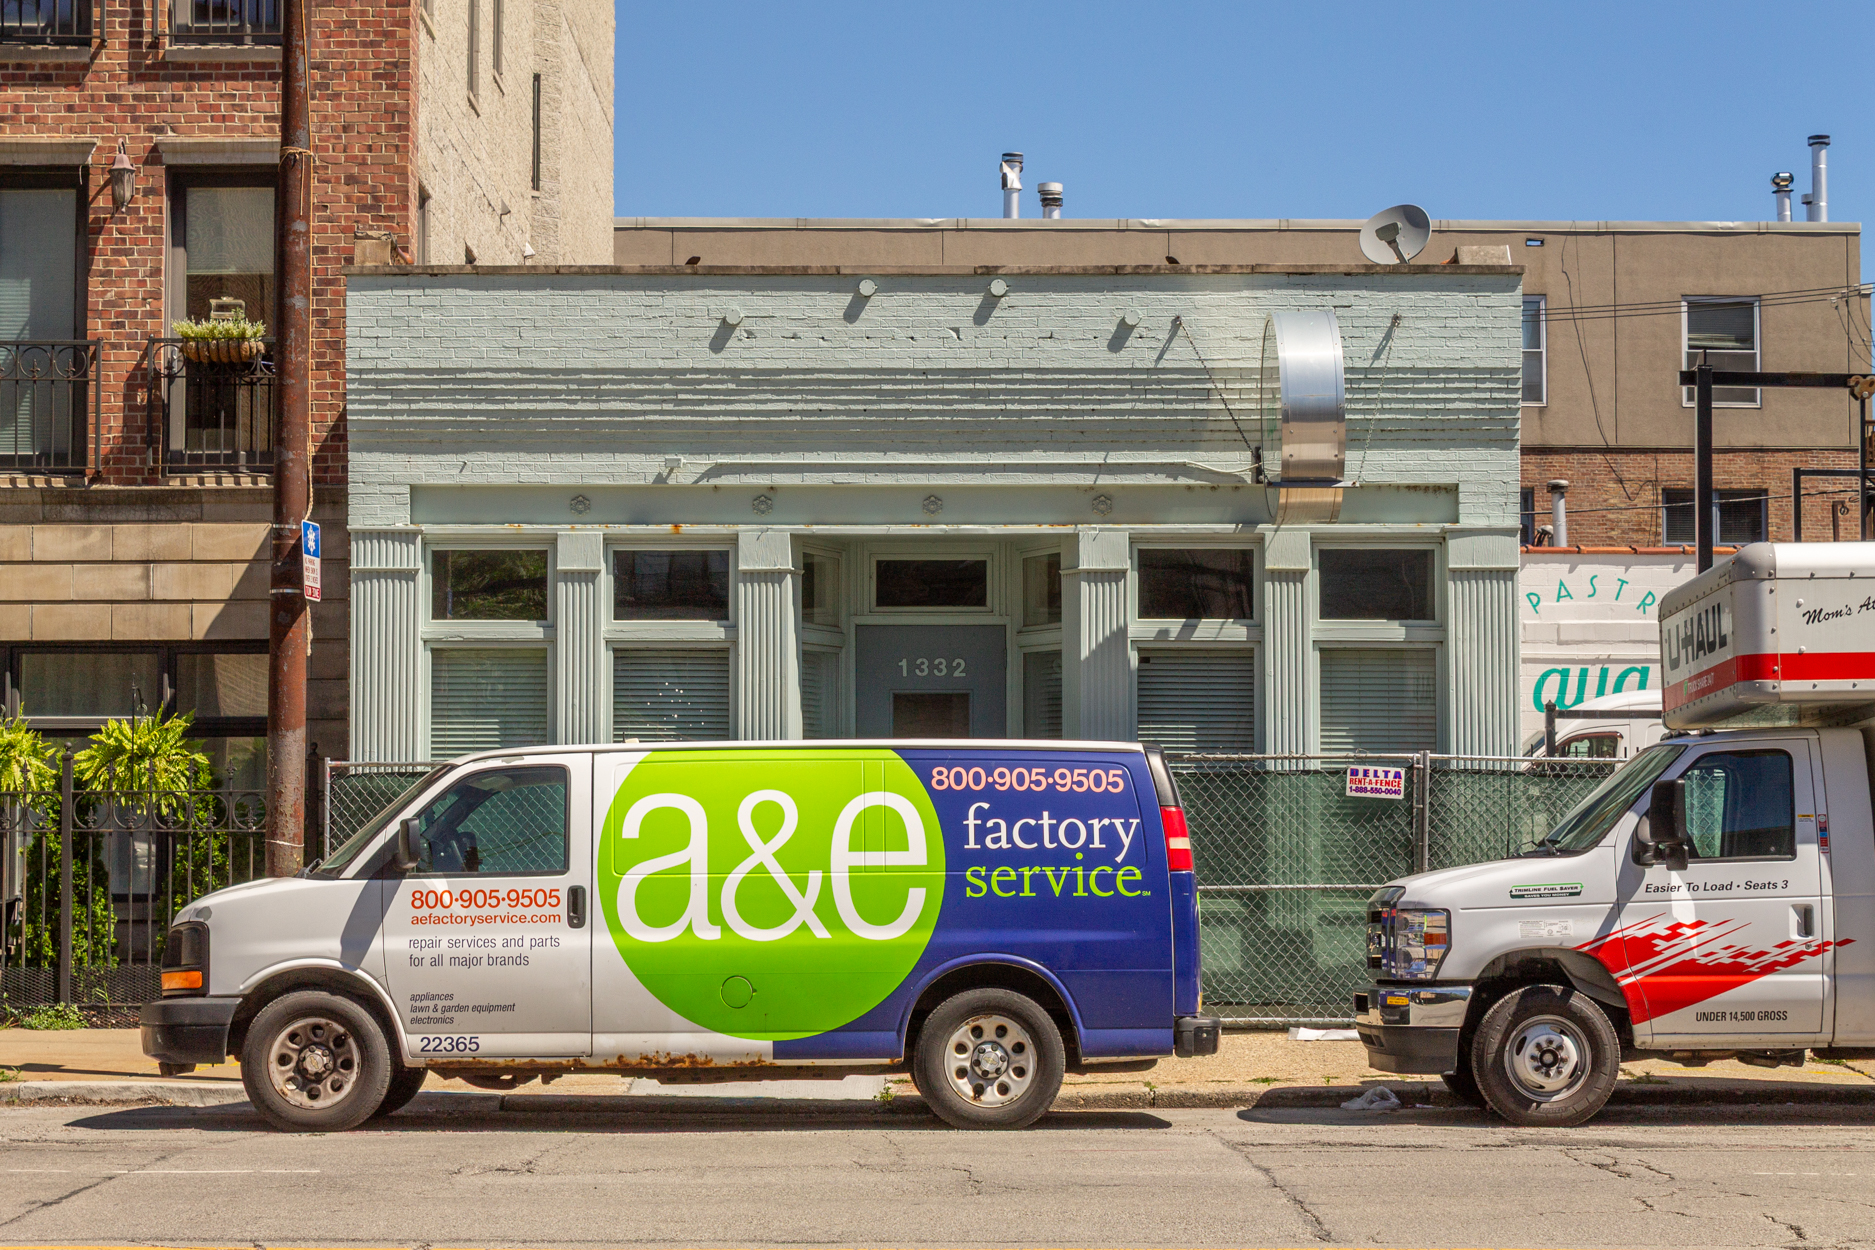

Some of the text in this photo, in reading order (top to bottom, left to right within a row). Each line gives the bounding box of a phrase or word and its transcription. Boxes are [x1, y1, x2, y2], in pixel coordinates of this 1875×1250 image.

[1802, 604, 1853, 625] Mom's
[898, 657, 967, 677] 1332
[1349, 768, 1402, 780] DELTA
[1349, 778, 1402, 789] RENT-A-FENCE
[1349, 785, 1402, 796] 1-888-550-0040
[963, 802, 1140, 864] factory
[616, 788, 928, 943] a&e
[965, 852, 1142, 898] service
[1644, 879, 1789, 894] Easier To Load Seats 3
[410, 911, 561, 927] aefactoryservice.com
[409, 934, 561, 951] repair services and parts
[409, 952, 530, 969] for all major brands
[410, 992, 454, 1003] appliances
[410, 1003, 516, 1015] lawn & garden equipment
[1695, 1010, 1788, 1023] UNDER 14,500 GROSS
[410, 1015, 455, 1025] electronics
[420, 1036, 480, 1053] 22365
